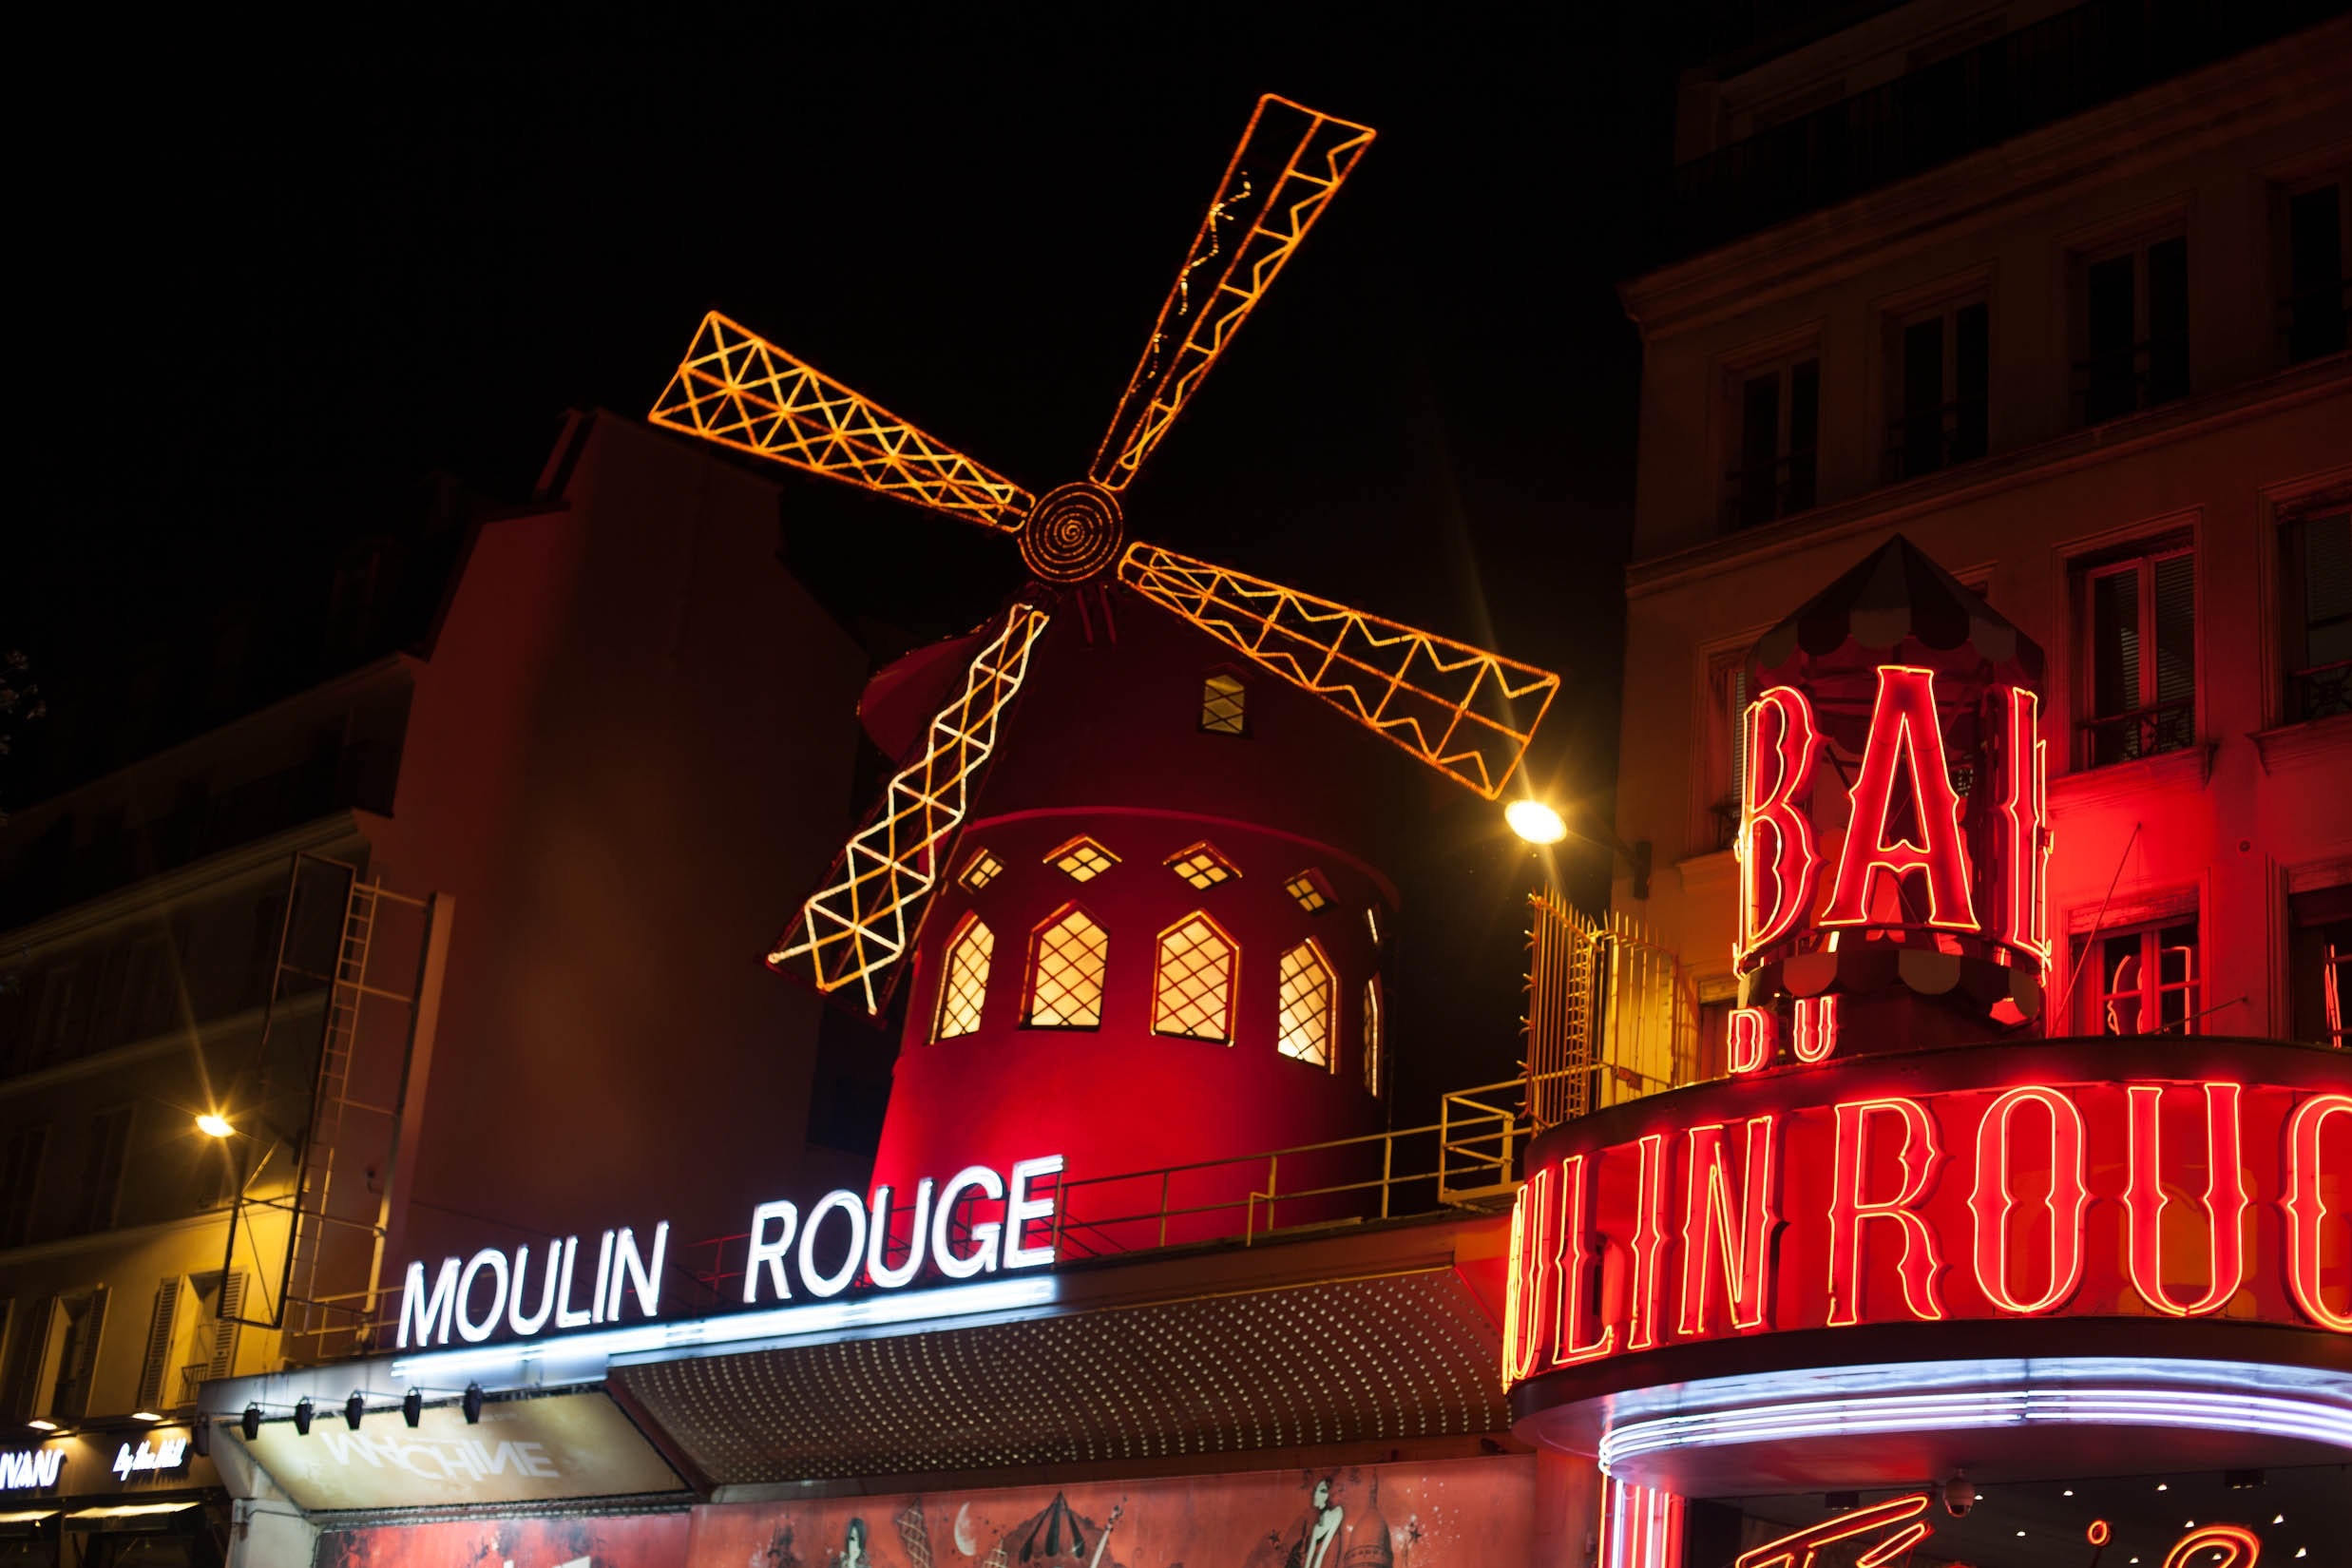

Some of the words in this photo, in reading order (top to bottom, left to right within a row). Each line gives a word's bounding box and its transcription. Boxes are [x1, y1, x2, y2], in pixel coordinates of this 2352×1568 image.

[1727, 996, 1834, 1074] DU
[396, 1219, 669, 1348] MOULIN
[743, 1153, 1064, 1303] ROUGE
